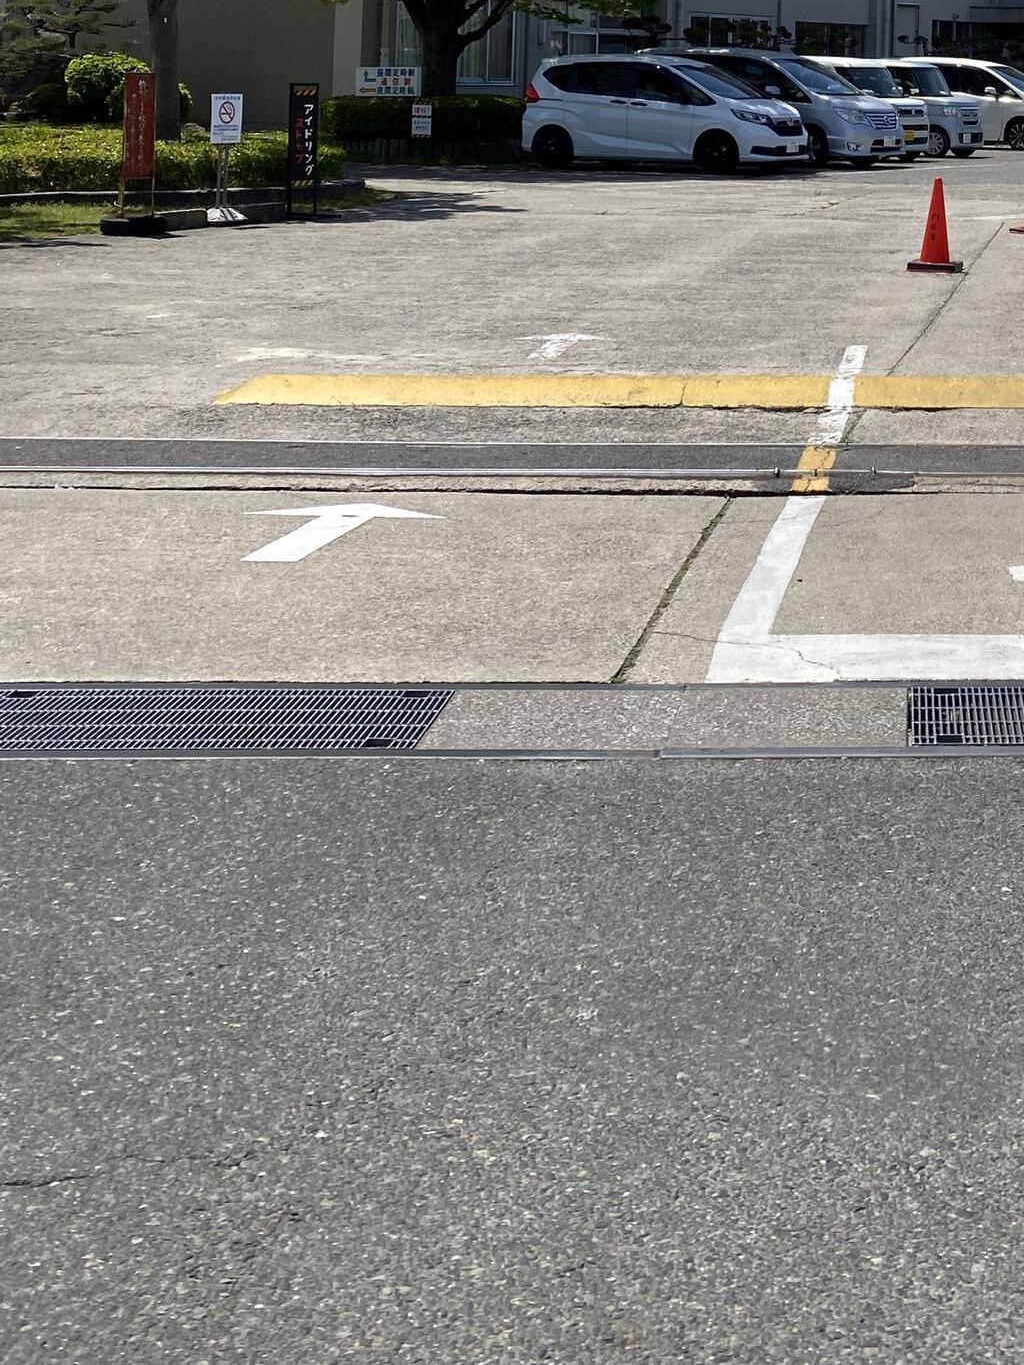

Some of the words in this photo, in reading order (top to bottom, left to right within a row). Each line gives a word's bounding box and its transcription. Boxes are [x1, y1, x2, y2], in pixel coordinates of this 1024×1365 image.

[377, 68, 416, 77] 昼間定時制
[304, 104, 314, 176] アイドリング
